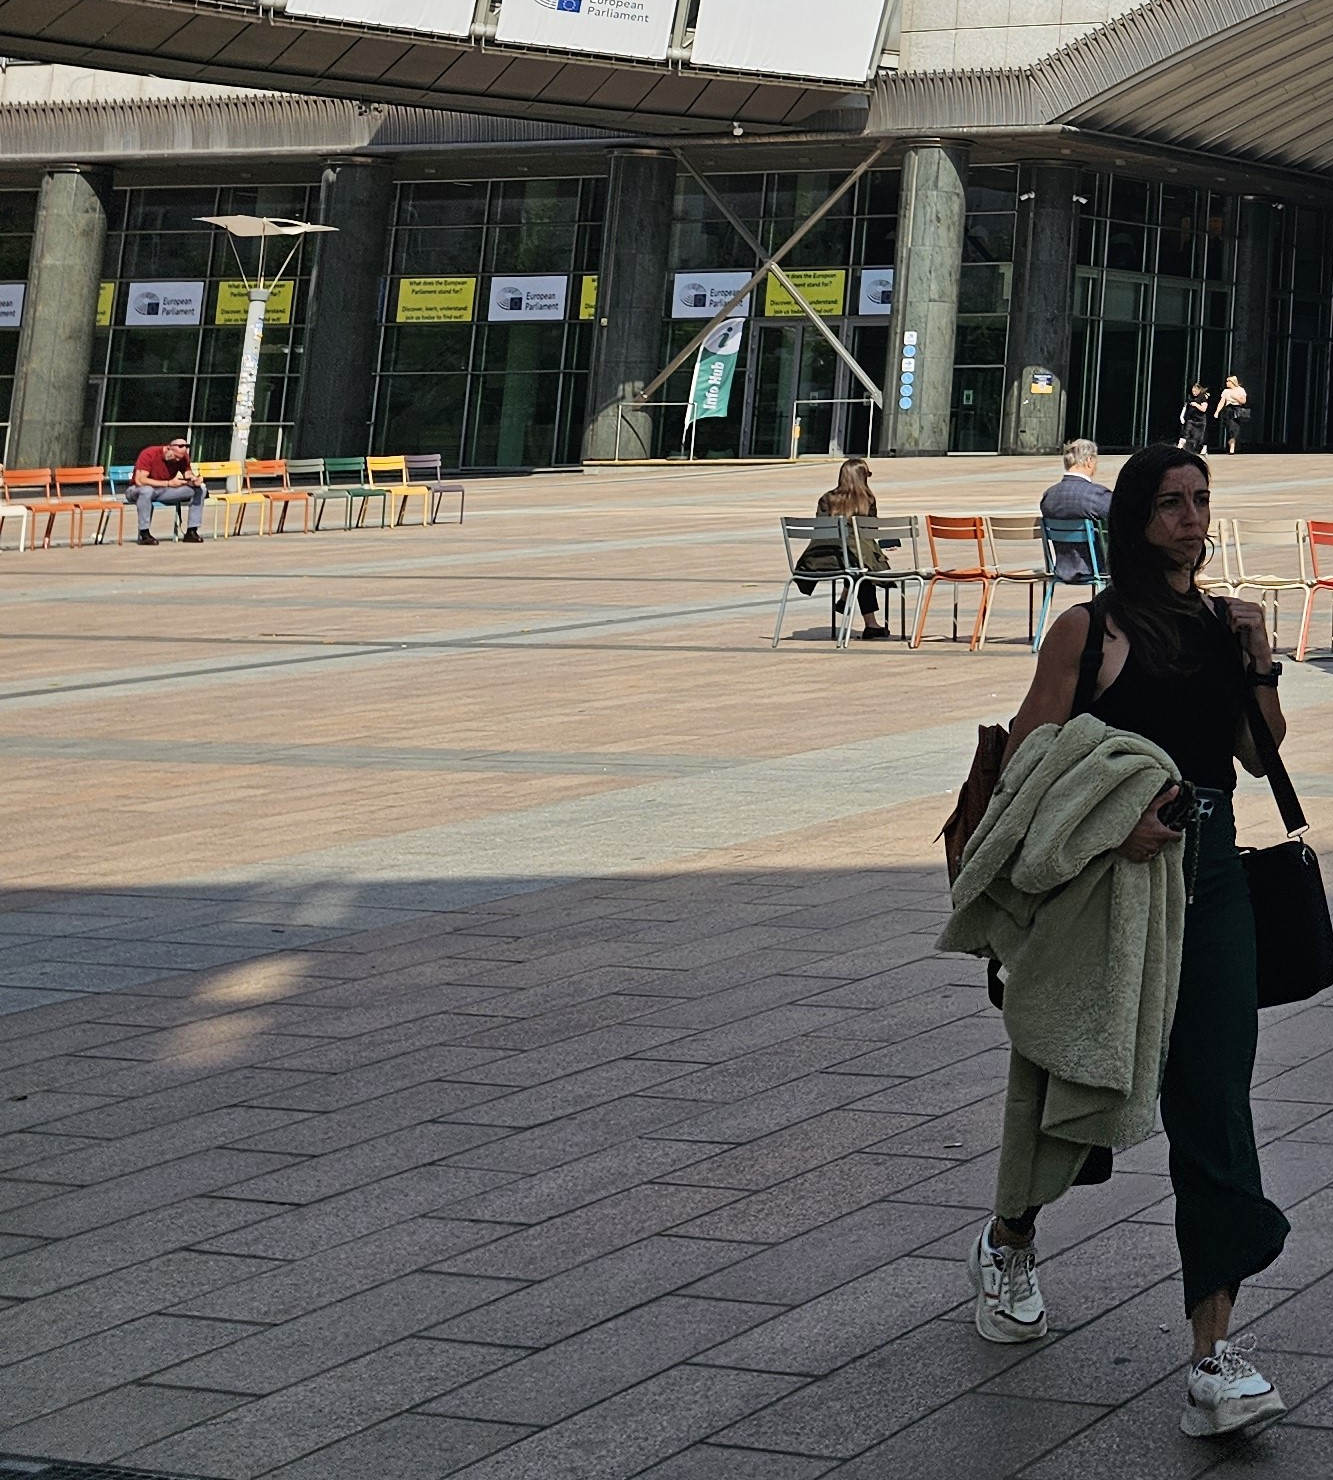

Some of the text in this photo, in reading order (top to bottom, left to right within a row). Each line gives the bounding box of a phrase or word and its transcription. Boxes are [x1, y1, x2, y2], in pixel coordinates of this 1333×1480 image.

[587, 6, 649, 23] Parliament
[526, 291, 556, 300] European
[525, 302, 559, 311] Parliament
[702, 361, 725, 410] Info Hub
